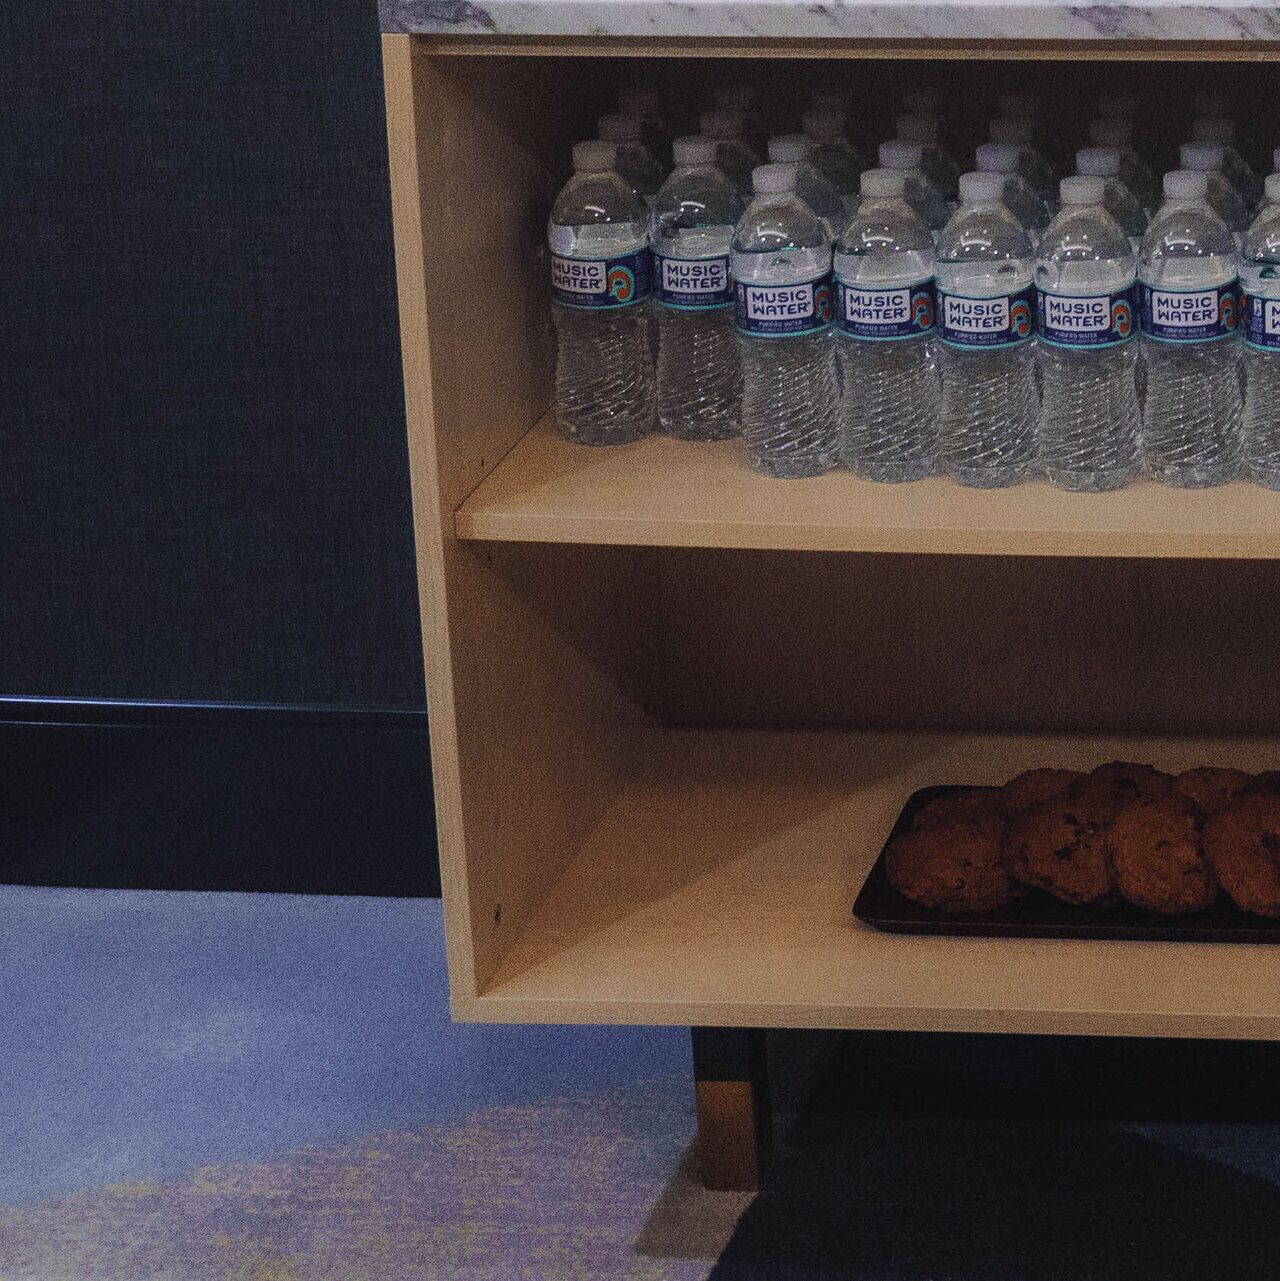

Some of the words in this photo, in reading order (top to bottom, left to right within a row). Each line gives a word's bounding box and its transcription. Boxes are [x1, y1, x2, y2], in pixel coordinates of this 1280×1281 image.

[552, 259, 599, 276] MUSIC
[667, 263, 720, 276] MUSIC
[553, 275, 600, 289] WATER
[667, 276, 721, 289] WATER
[752, 290, 807, 303] MUSIC
[850, 293, 904, 307] MUSIC
[1157, 296, 1212, 309] MUSIC
[753, 303, 808, 316] WATER
[851, 307, 905, 320] WATER
[950, 301, 1003, 315] MUSIC
[1050, 300, 1103, 314] MUSIC
[950, 314, 1003, 328] WATER
[1051, 314, 1104, 327] WATER
[1158, 309, 1213, 322] WATER
